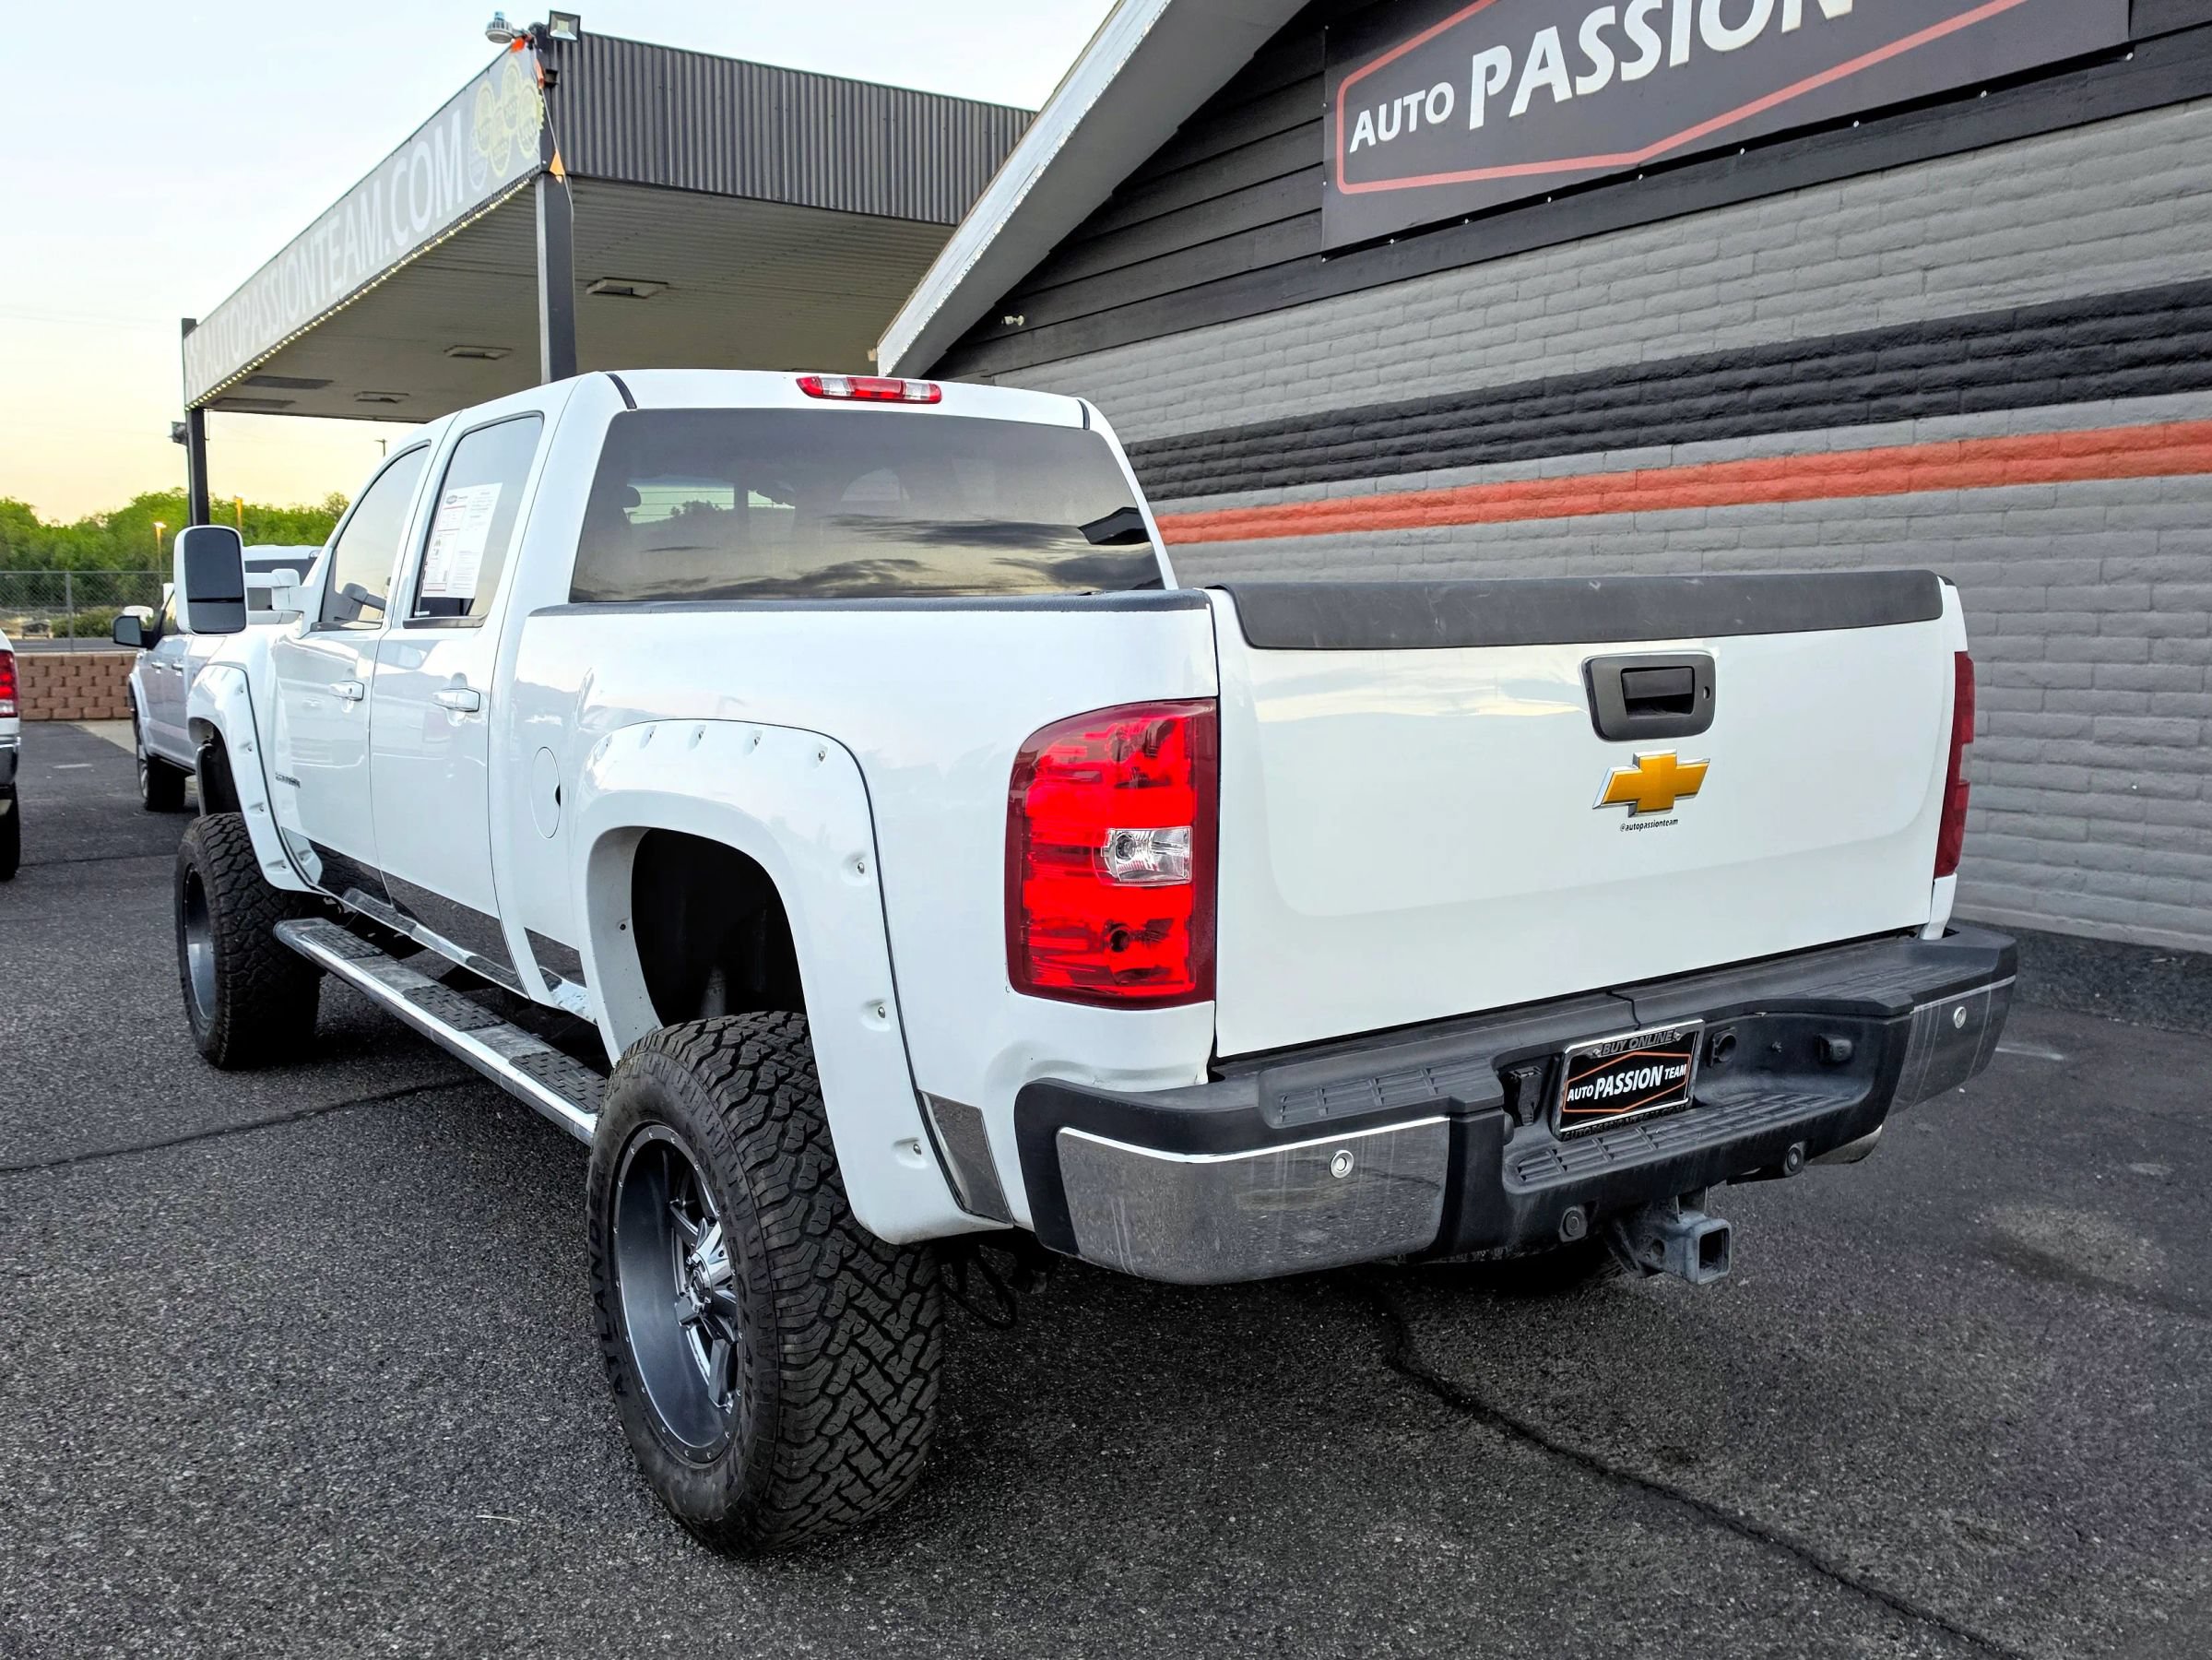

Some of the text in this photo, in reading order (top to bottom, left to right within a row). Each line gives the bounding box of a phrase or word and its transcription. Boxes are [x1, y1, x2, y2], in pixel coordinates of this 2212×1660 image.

[1349, 81, 1455, 154] AUTO
[198, 109, 462, 381] AUTOPASSIONTEAM.COM
[1619, 818, 1679, 832] @autopassionteam
[1603, 1029, 1674, 1056] BUY ONLINE
[1567, 1063, 1687, 1102] AUTO PASSION TEAM
